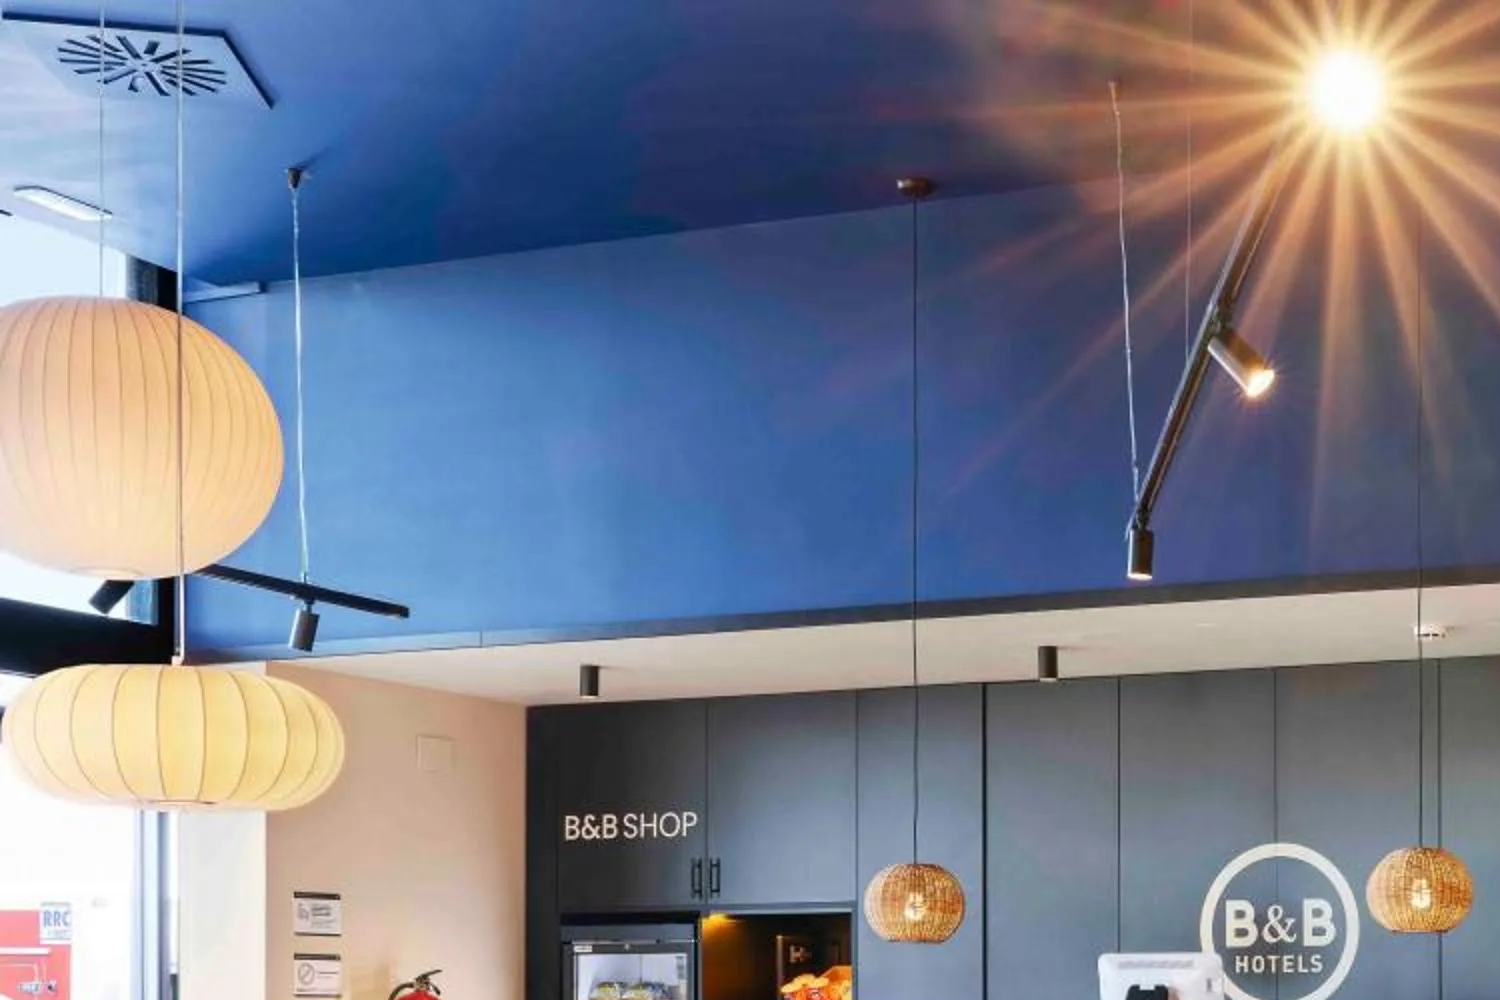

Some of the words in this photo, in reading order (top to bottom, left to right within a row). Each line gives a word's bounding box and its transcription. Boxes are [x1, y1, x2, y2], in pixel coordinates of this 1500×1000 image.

[564, 813, 617, 841] B&B
[622, 812, 698, 840] SHOP
[1225, 899, 1336, 947] B&B
[1235, 955, 1323, 974] HOTELS
